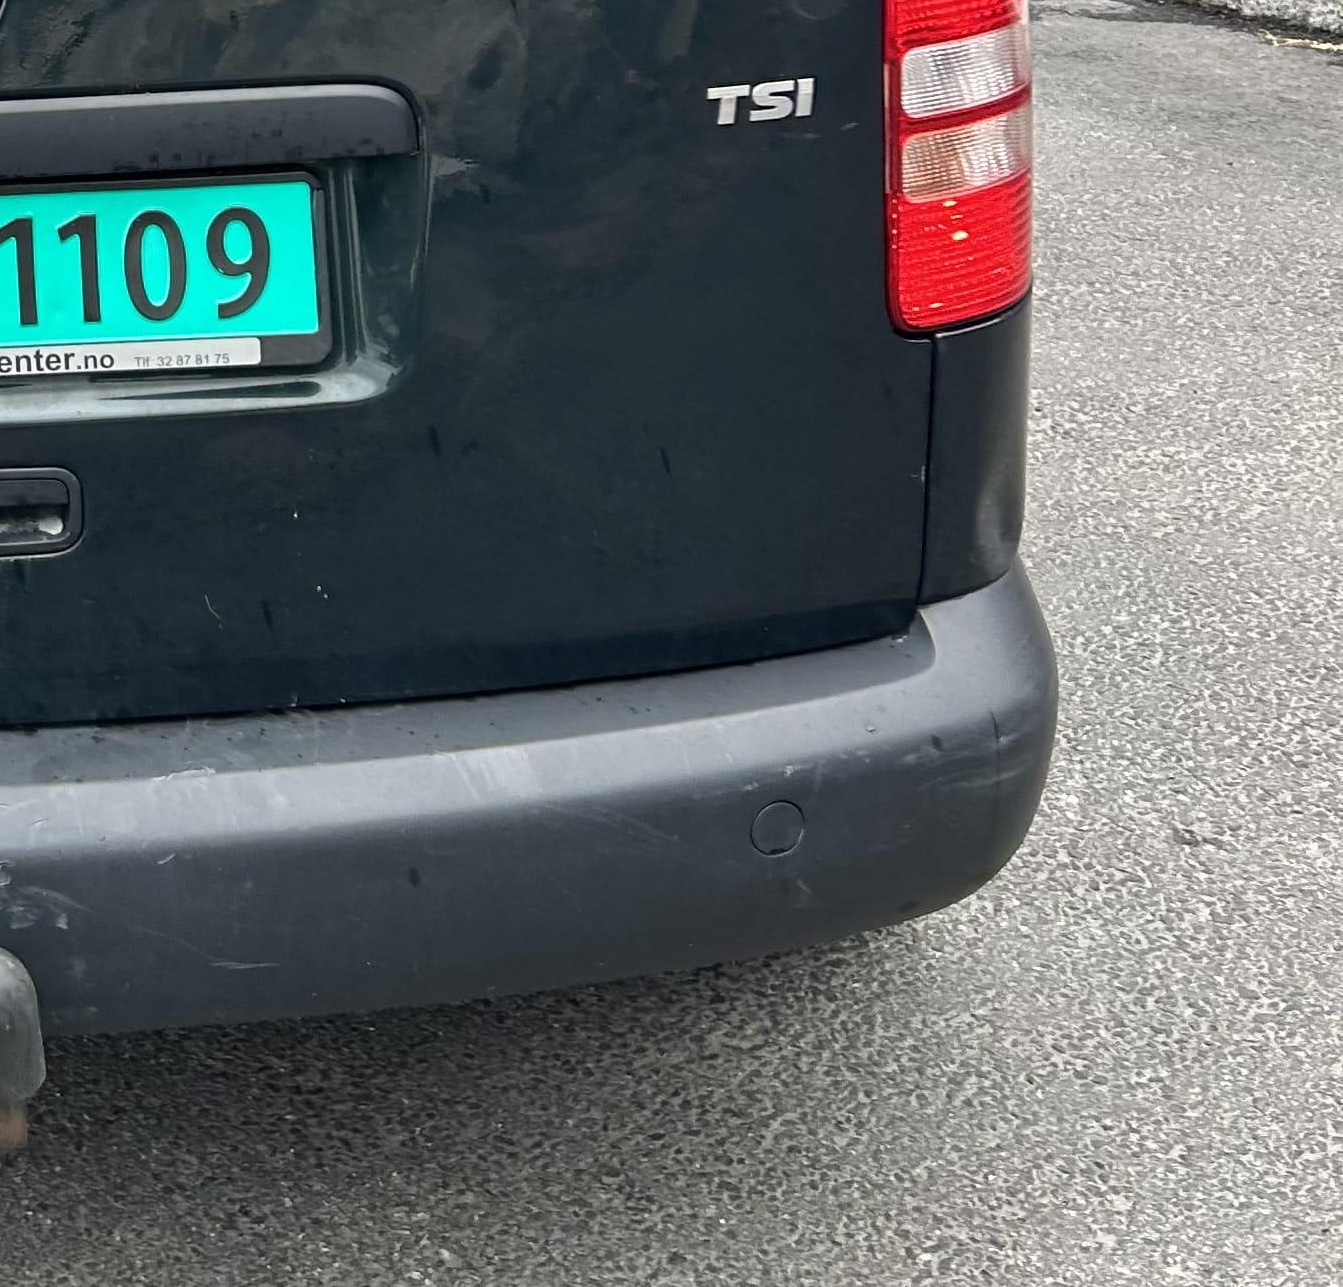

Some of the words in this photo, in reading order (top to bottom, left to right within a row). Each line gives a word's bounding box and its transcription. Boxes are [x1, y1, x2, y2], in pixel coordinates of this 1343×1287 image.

[707, 77, 815, 125] TSI
[156, 355, 173, 367] 32
[175, 354, 192, 367] 87
[194, 353, 210, 366] 81
[214, 352, 230, 364] 75
